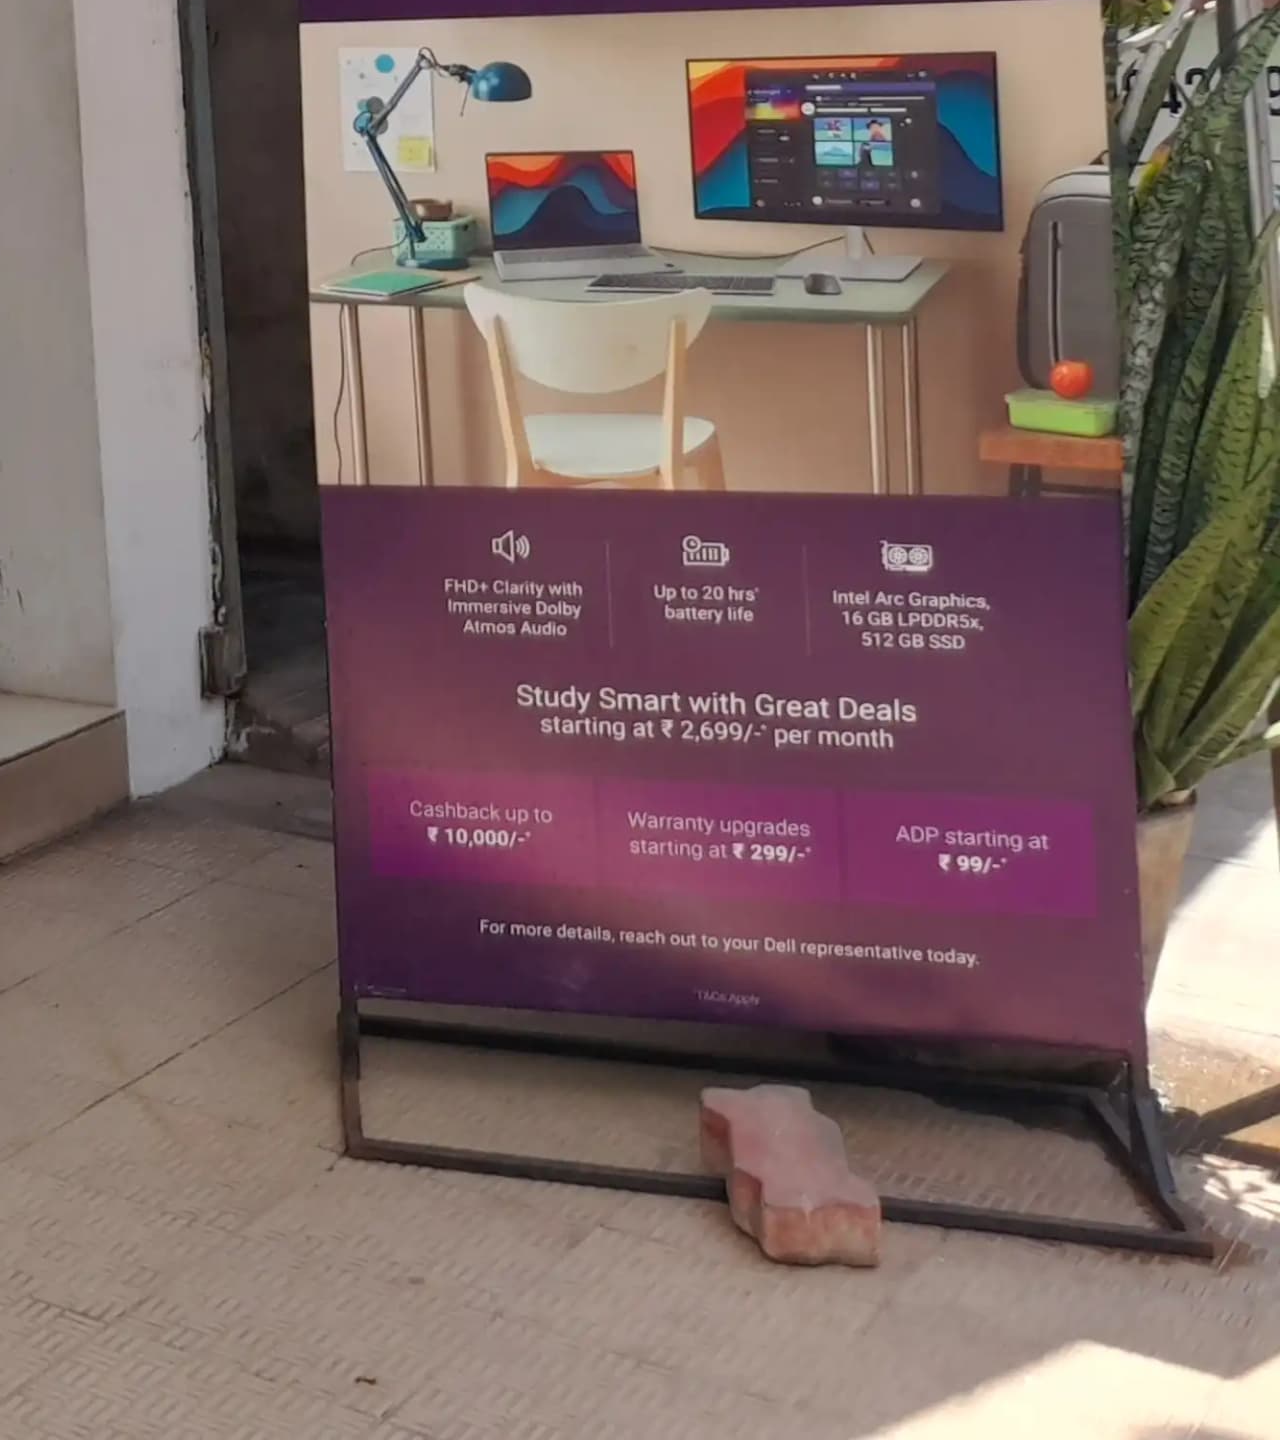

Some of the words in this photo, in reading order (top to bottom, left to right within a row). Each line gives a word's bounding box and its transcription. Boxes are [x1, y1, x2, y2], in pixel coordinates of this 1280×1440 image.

[444, 578, 489, 594] FHD+
[493, 580, 544, 598] Clarity
[548, 581, 583, 596] with
[653, 584, 677, 602] Up
[681, 586, 697, 600] to
[702, 586, 724, 601] 20
[448, 599, 531, 614] Immersive
[536, 602, 581, 619] Dolby
[833, 590, 870, 605] Intel
[874, 593, 904, 606] Arc
[908, 592, 991, 611] Graphics,
[665, 606, 722, 624] battery
[727, 607, 754, 621] life
[842, 611, 863, 625] 16
[868, 611, 893, 627] GB
[463, 620, 516, 635] Atmos
[520, 622, 567, 637] Audio
[861, 632, 894, 647] 512
[898, 633, 924, 648] GB
[929, 634, 966, 650] SSD
[516, 684, 591, 714] Study
[598, 688, 680, 713] Smart
[689, 691, 746, 716] with
[754, 693, 830, 719] Great
[839, 697, 917, 723] Deals
[540, 716, 626, 742] starting
[632, 719, 654, 738] at
[774, 727, 811, 749] per
[818, 728, 894, 749] month
[410, 799, 499, 821] Cashback
[505, 807, 529, 825] up
[534, 807, 553, 823] to
[627, 810, 714, 837] Warranty
[720, 818, 811, 840] upgrades
[896, 825, 939, 844] ADP
[944, 829, 1024, 854] starting
[1028, 835, 1049, 851] at
[629, 839, 703, 862] starting
[708, 843, 727, 859] at
[479, 919, 506, 935] For
[510, 922, 553, 938] more
[556, 924, 617, 944] details,
[619, 929, 666, 945] reach
[669, 934, 697, 948] out
[701, 935, 719, 949] to
[723, 937, 759, 953] your
[764, 937, 796, 954] Dell
[800, 941, 923, 962] representative
[927, 948, 981, 969] today.
